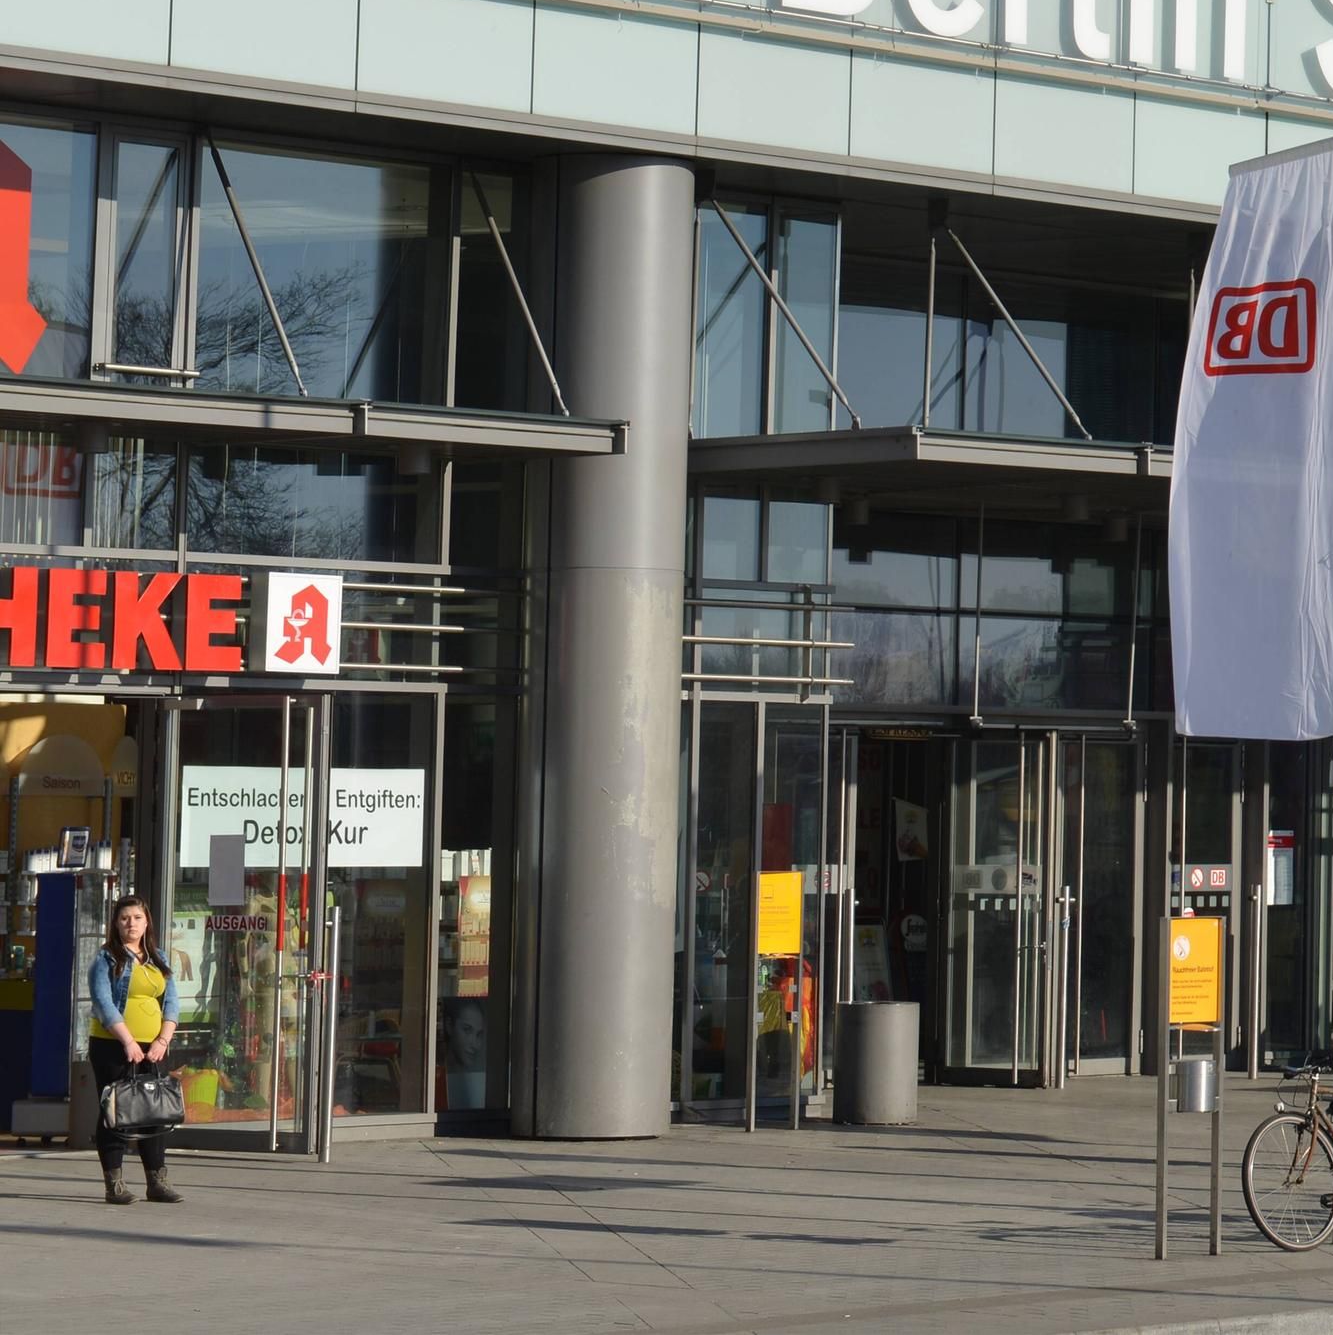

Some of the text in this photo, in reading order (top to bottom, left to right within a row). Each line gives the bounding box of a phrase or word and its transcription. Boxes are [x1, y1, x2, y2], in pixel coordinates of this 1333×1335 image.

[42, 776, 81, 789] Saison
[335, 788, 421, 813] Entgiften:
[328, 819, 369, 845] Kur
[1211, 871, 1225, 884] DB
